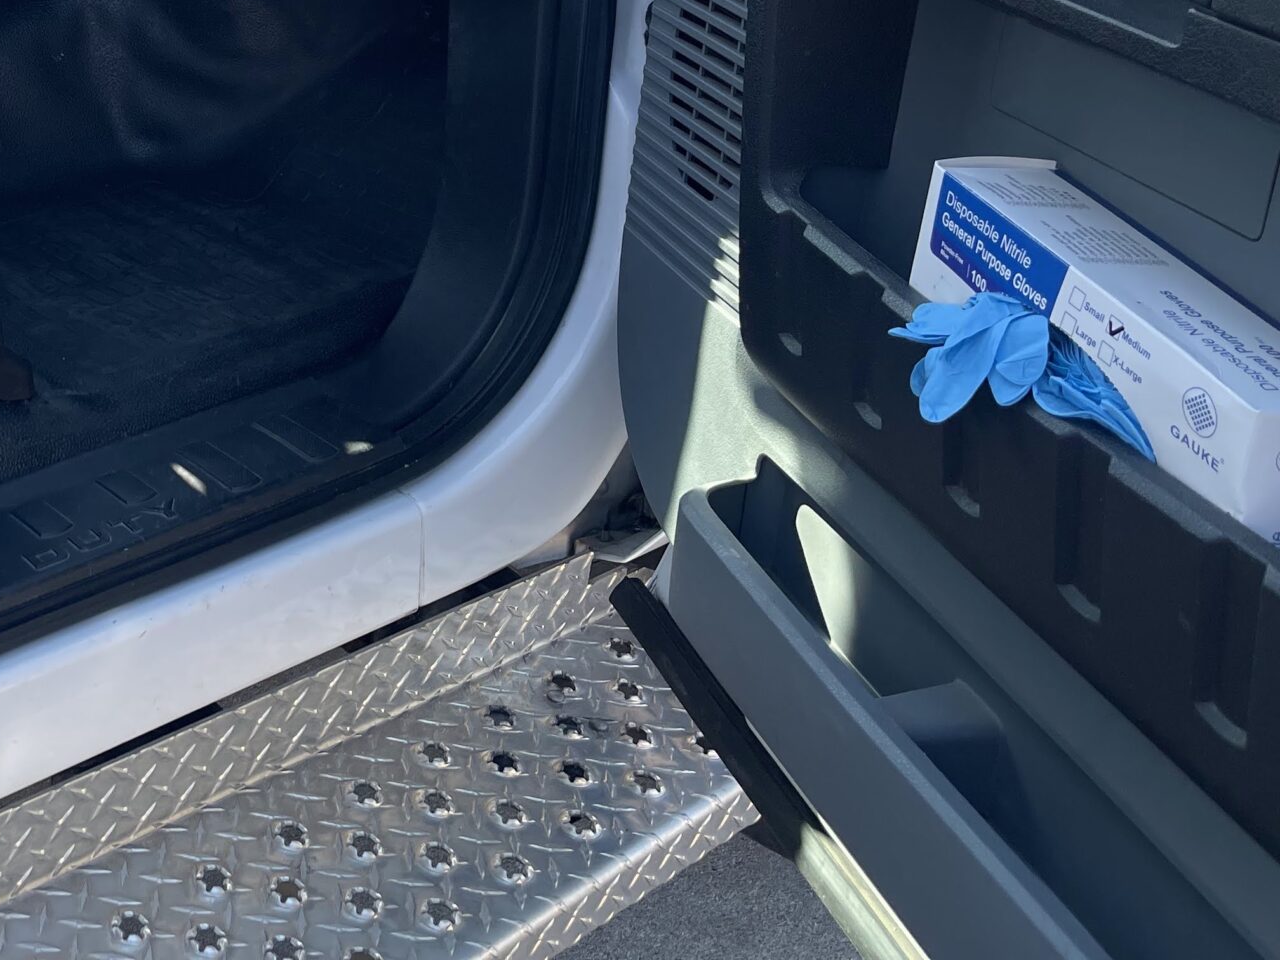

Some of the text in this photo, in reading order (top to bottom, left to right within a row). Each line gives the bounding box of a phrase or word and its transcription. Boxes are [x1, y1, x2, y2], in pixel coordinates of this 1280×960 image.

[942, 212, 976, 250] General
[975, 239, 1012, 281] Purpose
[1012, 272, 1048, 310] Gloves
[946, 190, 999, 243] Disposable
[1000, 234, 1032, 269] Nitrile
[971, 269, 987, 292] 100
[1075, 325, 1143, 384] Large X-Large
[1083, 302, 1151, 360] Small Medium
[1163, 309, 1280, 391] Disposable Nitrile
[22, 497, 179, 571] DUTY
